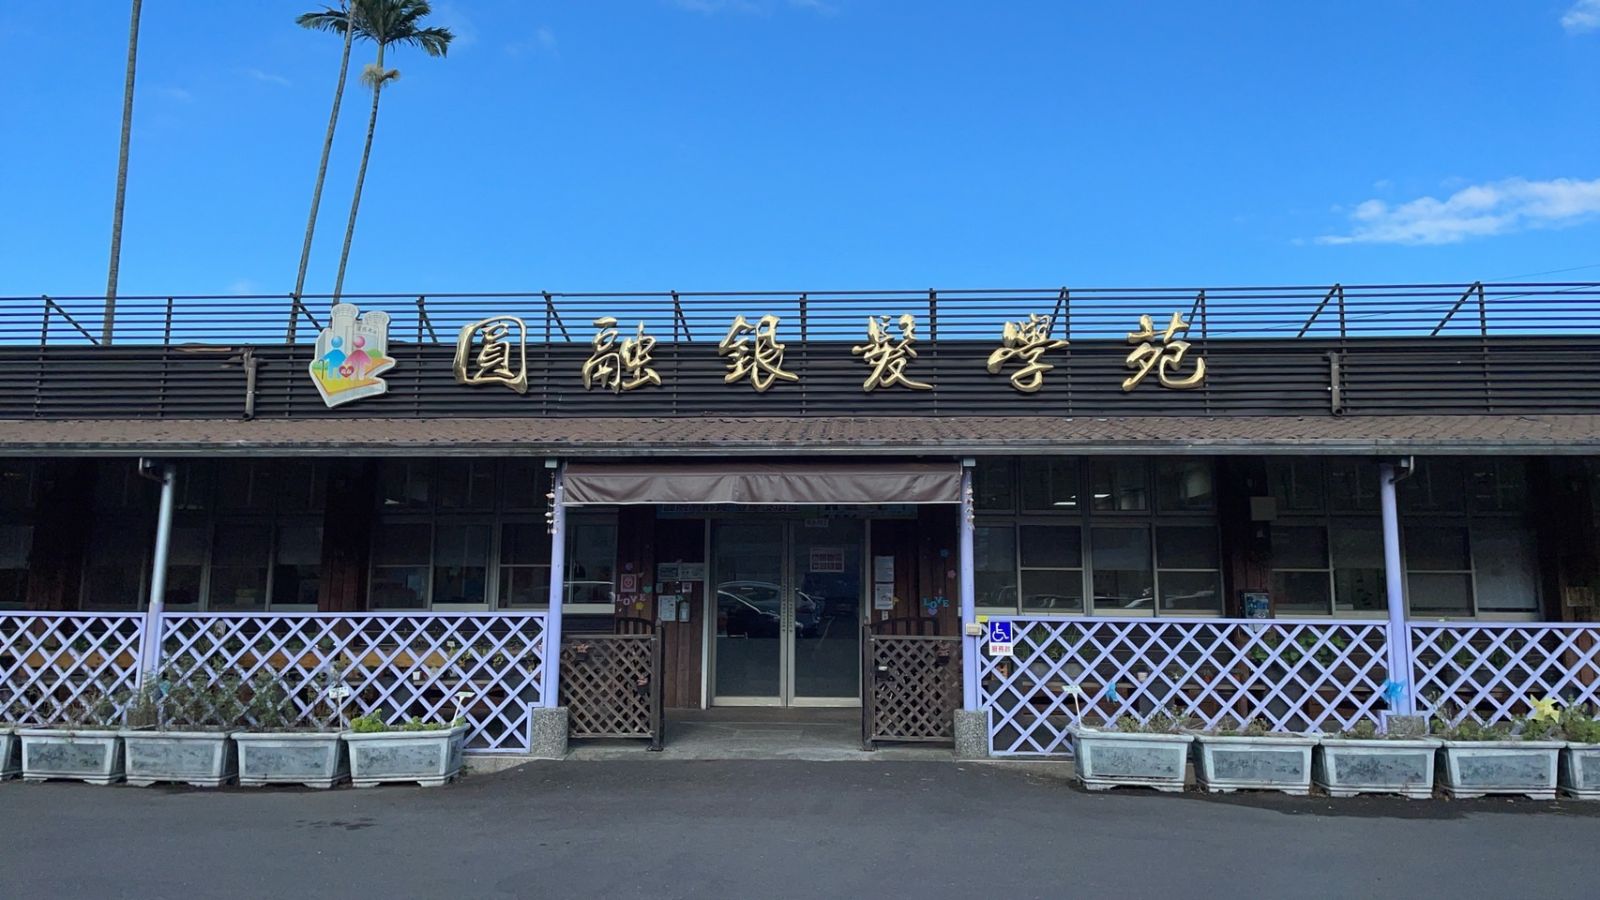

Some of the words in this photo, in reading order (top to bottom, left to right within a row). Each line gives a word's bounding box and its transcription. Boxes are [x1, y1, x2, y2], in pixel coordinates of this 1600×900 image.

[453, 313, 1207, 395] 圓融銀髮學苑
